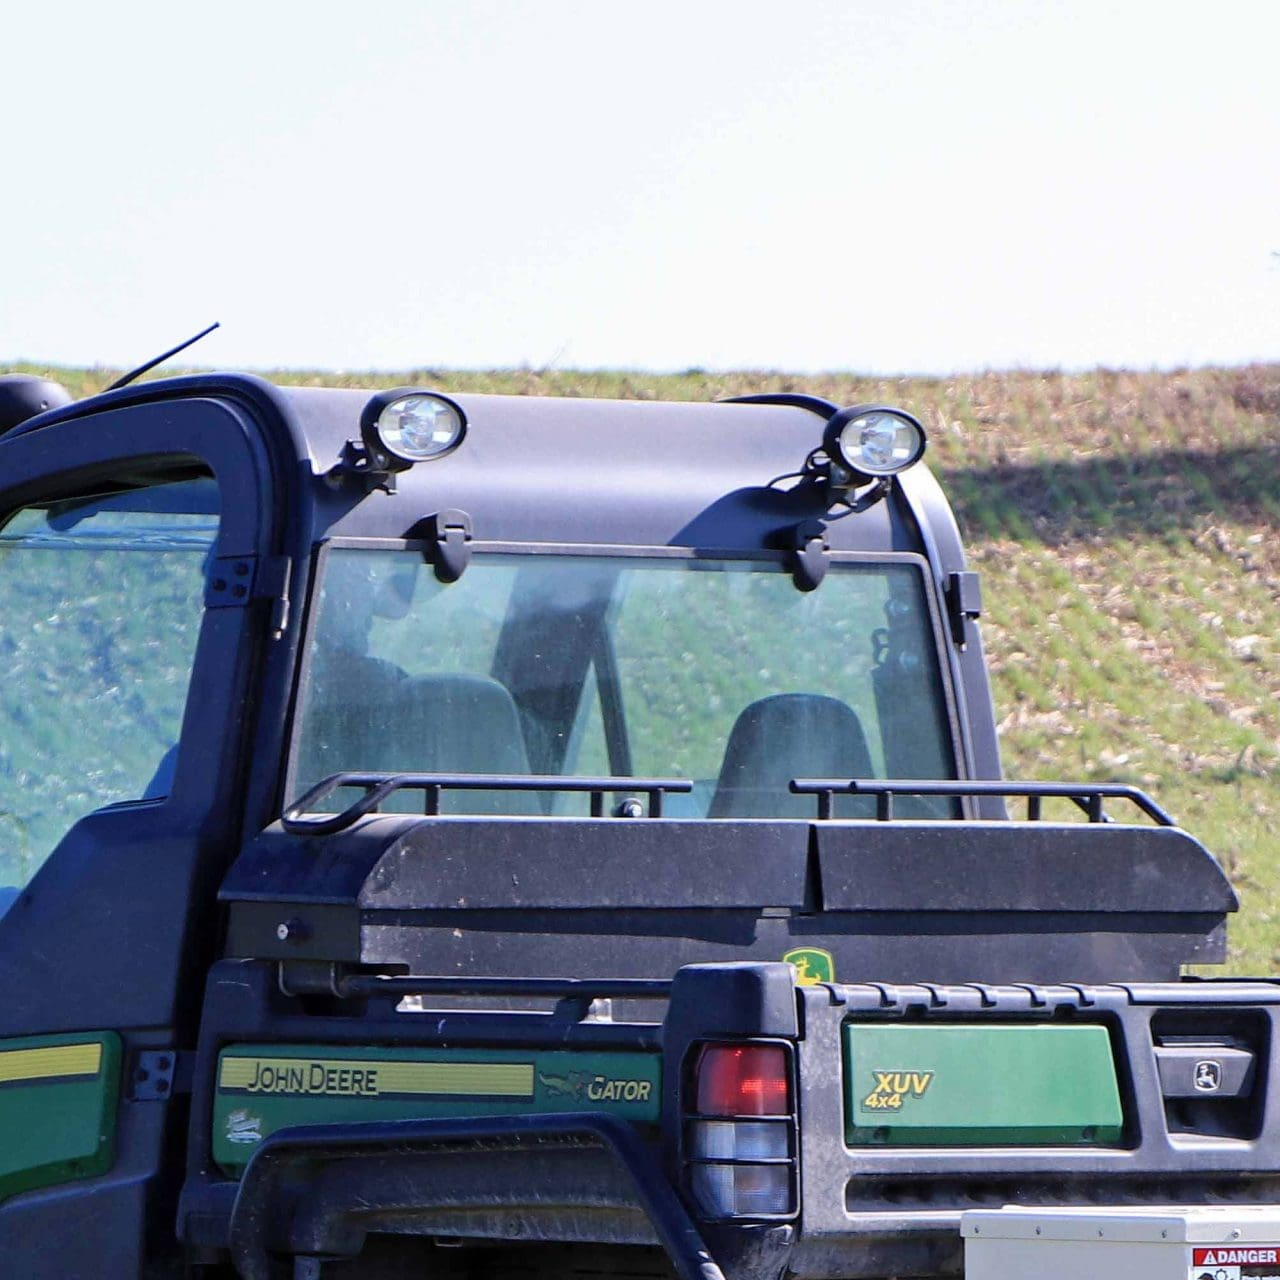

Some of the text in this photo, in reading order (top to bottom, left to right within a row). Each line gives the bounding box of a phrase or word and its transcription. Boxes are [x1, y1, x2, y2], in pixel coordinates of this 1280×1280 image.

[247, 1061, 378, 1092] JOHN DEERE
[874, 1072, 931, 1094] XUV
[587, 1076, 651, 1101] GATOR
[864, 1093, 902, 1109] 4x4
[1217, 1250, 1277, 1263] DANGER
